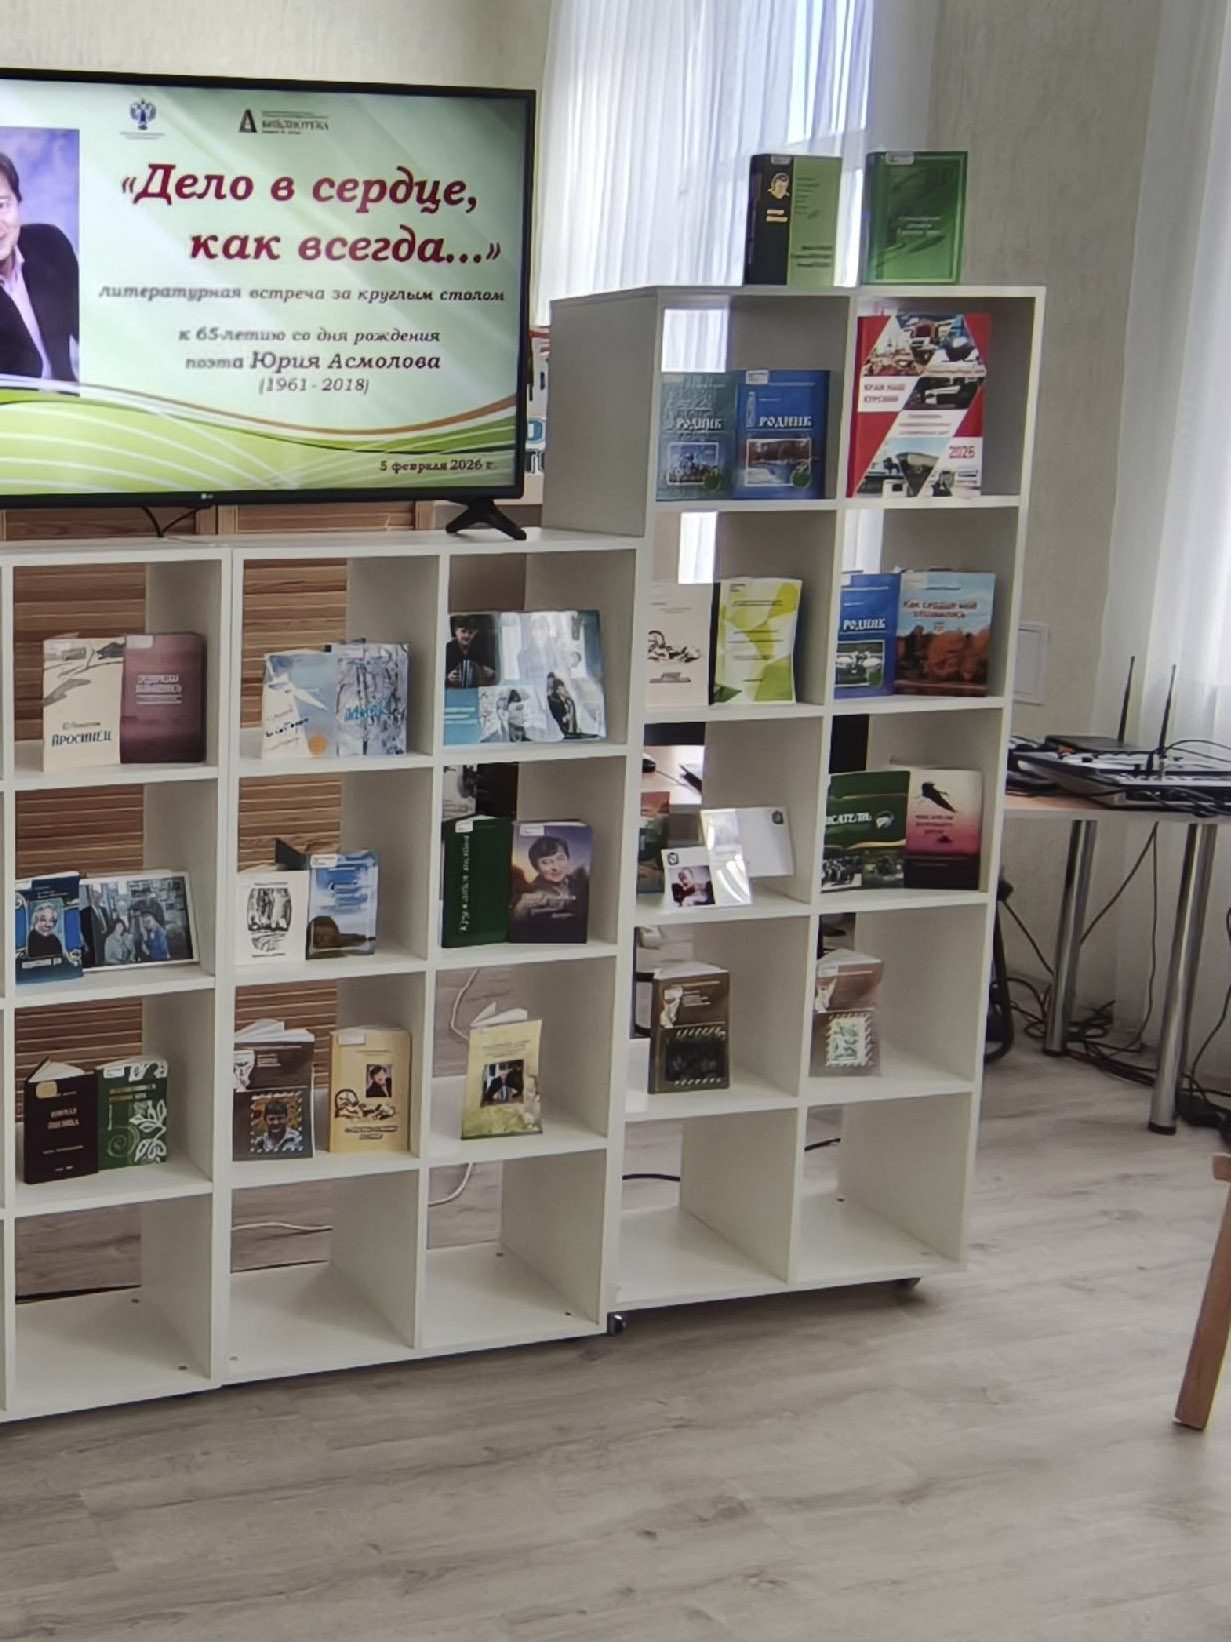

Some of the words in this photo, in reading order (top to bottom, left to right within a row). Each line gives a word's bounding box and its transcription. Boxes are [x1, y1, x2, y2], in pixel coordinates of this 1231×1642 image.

[121, 163, 255, 206] «Дело
[270, 176, 296, 202] в
[312, 165, 478, 214] сердце,
[189, 234, 281, 260] как
[298, 223, 502, 264] всегда...»
[98, 285, 242, 302] литературная
[249, 288, 325, 303] встреча
[332, 289, 352, 300] за
[357, 289, 433, 304] круглым
[439, 290, 505, 302] столом
[178, 329, 191, 341] к
[195, 326, 286, 342] 65-летию
[291, 331, 311, 342] со
[316, 326, 348, 342] дня
[353, 327, 441, 346] рождения
[185, 356, 245, 370] поэта
[250, 350, 321, 374] Юрия
[327, 352, 441, 370] Асмолова
[760, 416, 812, 429] РОДНИК
[380, 461, 388, 472] 5
[392, 462, 448, 475] февраля
[450, 459, 482, 471] 2026
